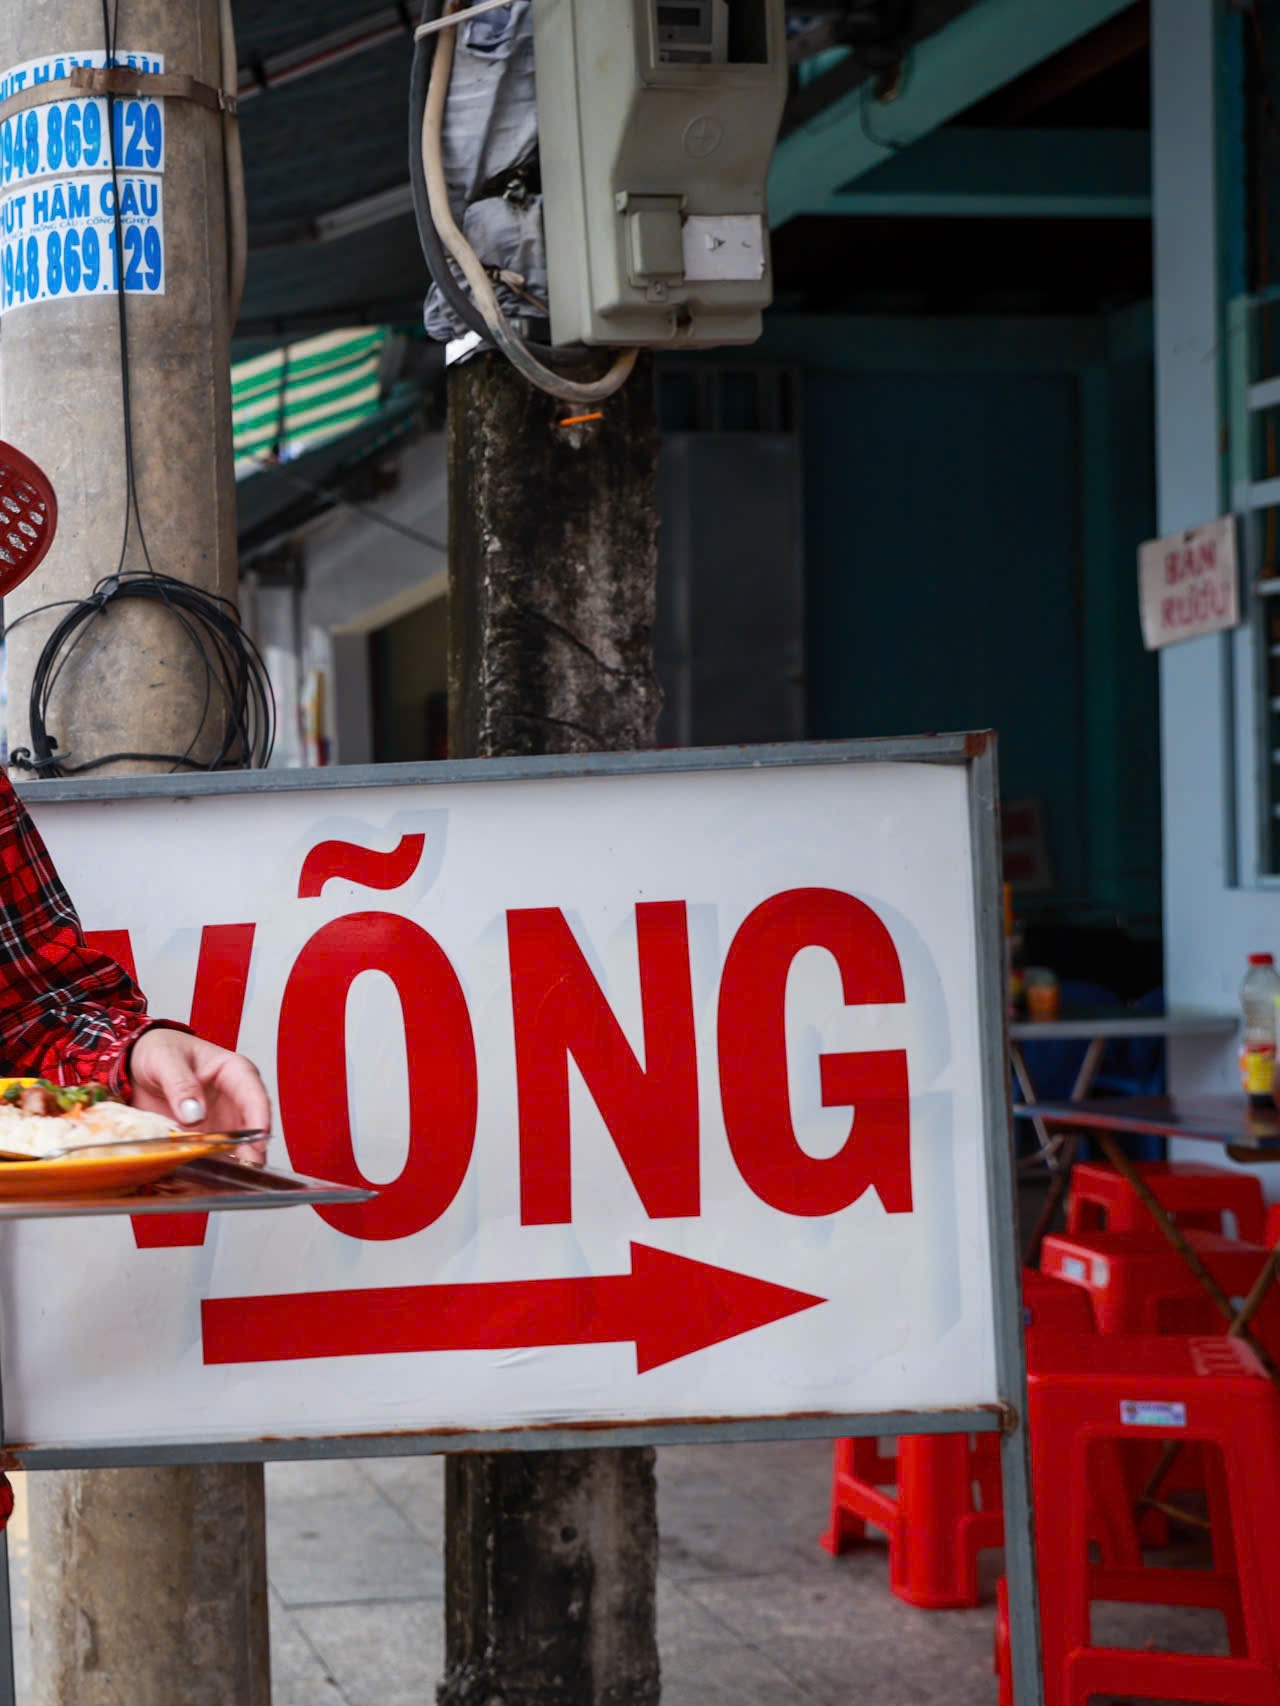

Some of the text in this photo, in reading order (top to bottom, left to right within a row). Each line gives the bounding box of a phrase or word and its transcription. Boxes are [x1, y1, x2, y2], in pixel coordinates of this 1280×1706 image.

[33, 56, 92, 85] HẦ
[33, 181, 91, 225] HẦM
[99, 178, 159, 217] CẦU
